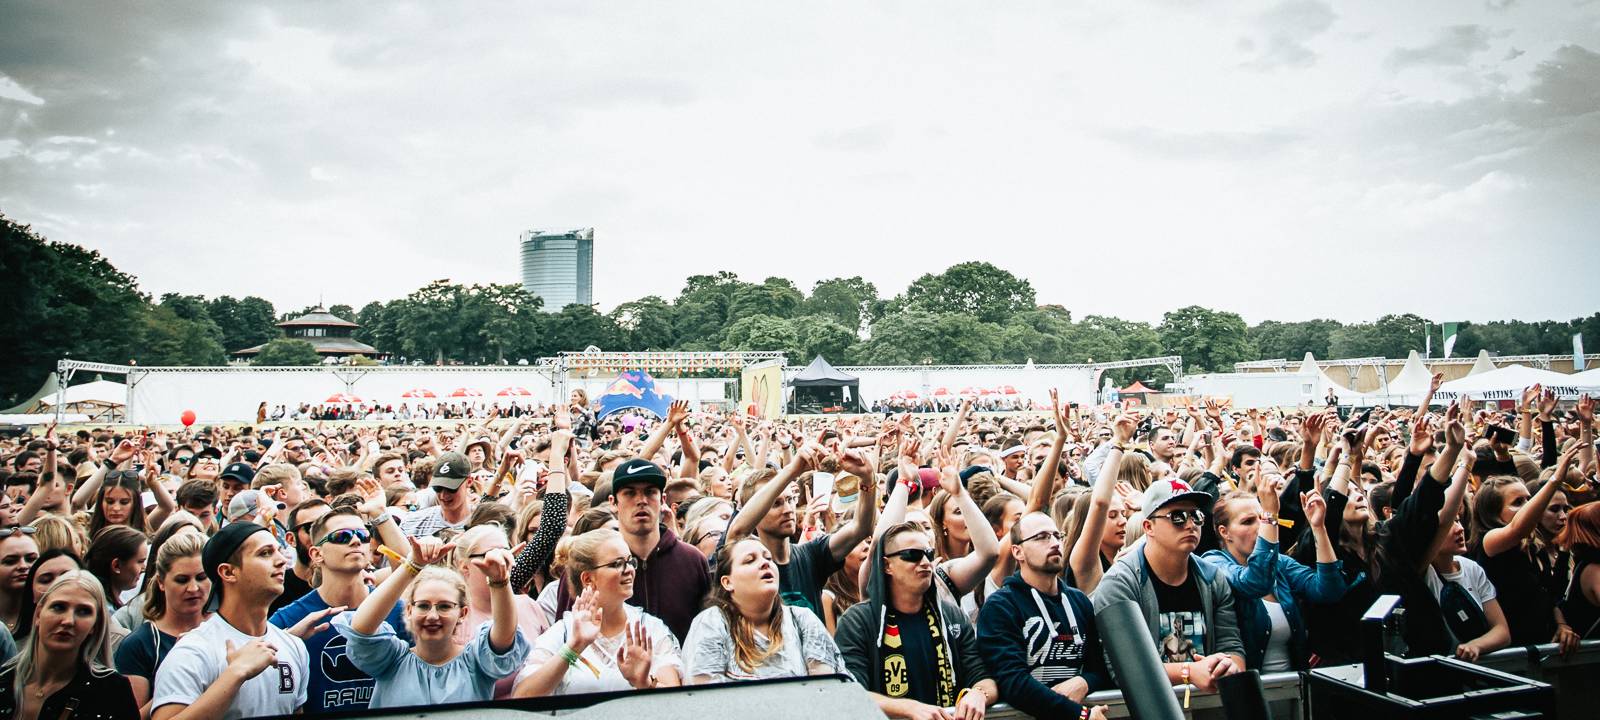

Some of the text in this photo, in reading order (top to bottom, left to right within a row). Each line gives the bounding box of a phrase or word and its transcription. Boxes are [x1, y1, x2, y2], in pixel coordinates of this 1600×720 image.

[1434, 391, 1458, 400] ELTINS
[1482, 389, 1513, 400] VELTINS
[277, 661, 295, 694] B
[884, 661, 908, 685] BVB
[890, 683, 901, 693] 09
[323, 686, 375, 708] RAW
